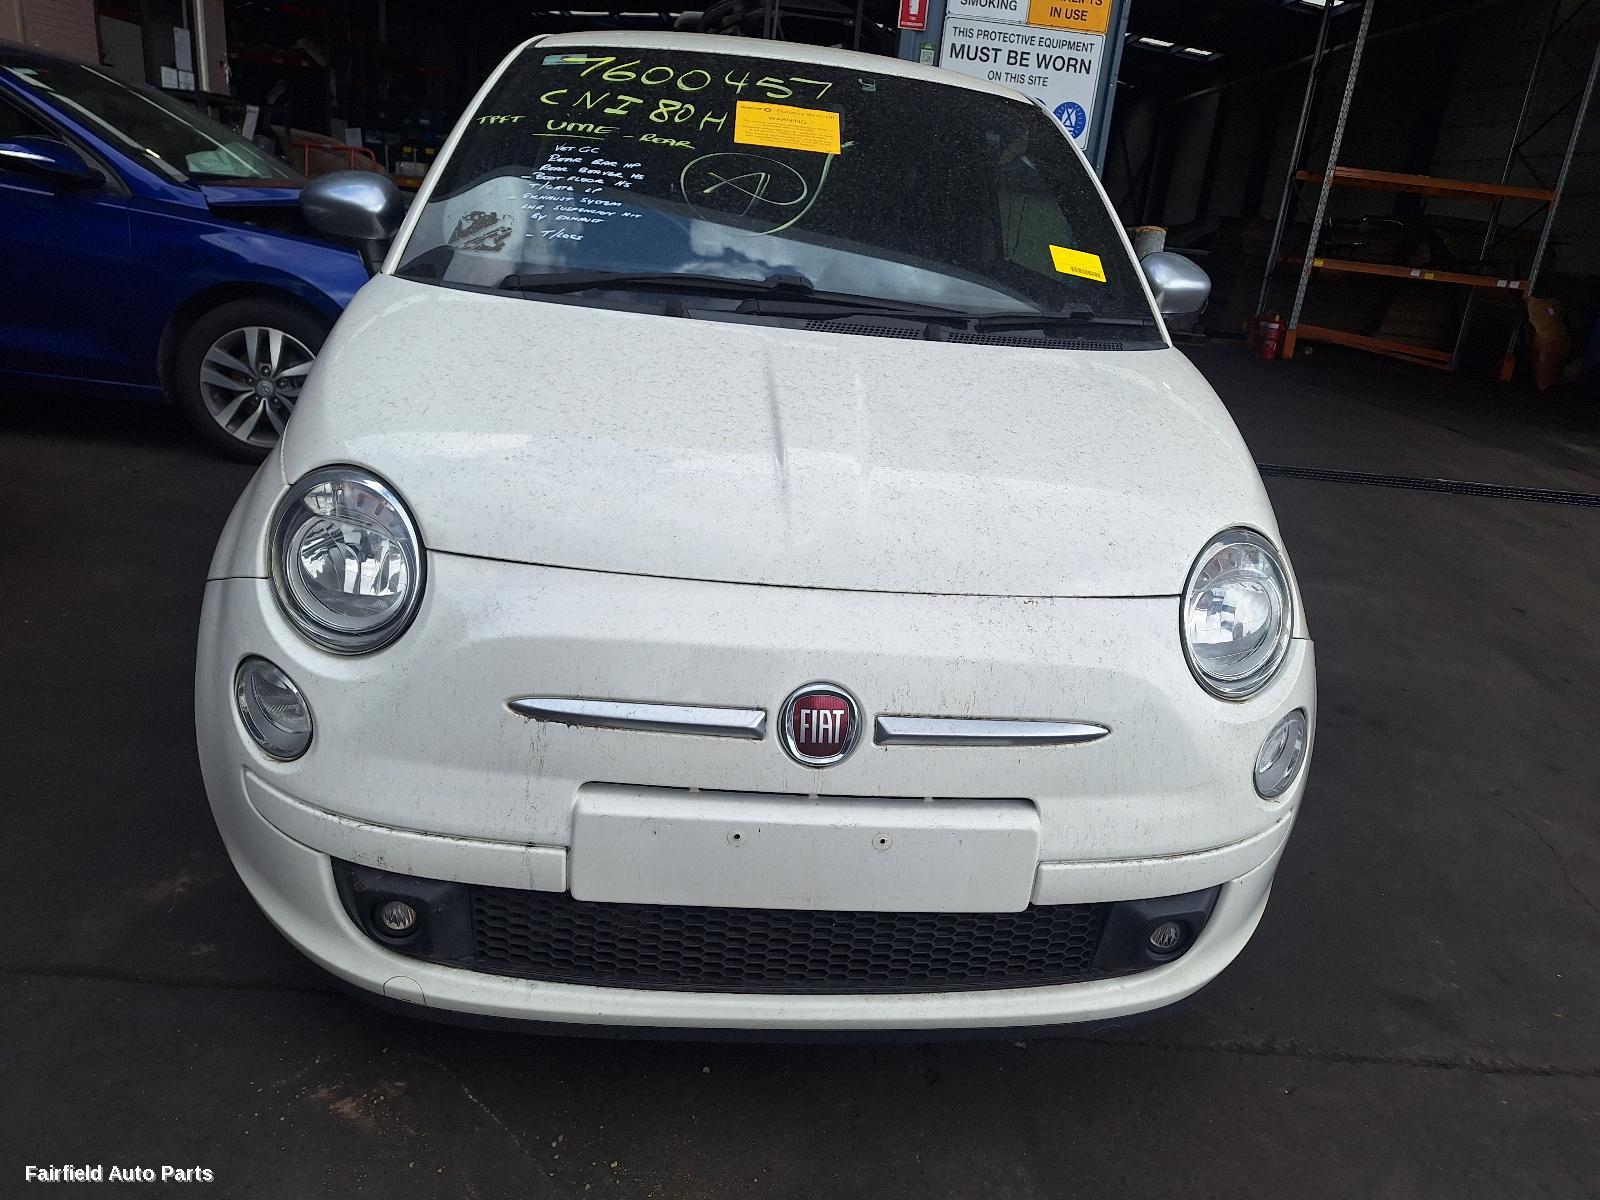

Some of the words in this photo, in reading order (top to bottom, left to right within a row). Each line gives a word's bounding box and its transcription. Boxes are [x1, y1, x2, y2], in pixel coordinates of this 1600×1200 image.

[1050, 6, 1062, 18] IN
[1065, 8, 1088, 21] USE
[952, 26, 975, 39] THIS
[976, 29, 1035, 46] PROTECTIVE
[1038, 36, 1095, 53] EQUIPMENT
[950, 43, 1002, 63] MUST
[1006, 49, 1030, 67] BE
[1036, 53, 1092, 75] WORN
[987, 70, 1002, 81] ON
[1004, 72, 1027, 84] THIS
[1028, 75, 1049, 87] SITE
[799, 708, 845, 744] FIAT
